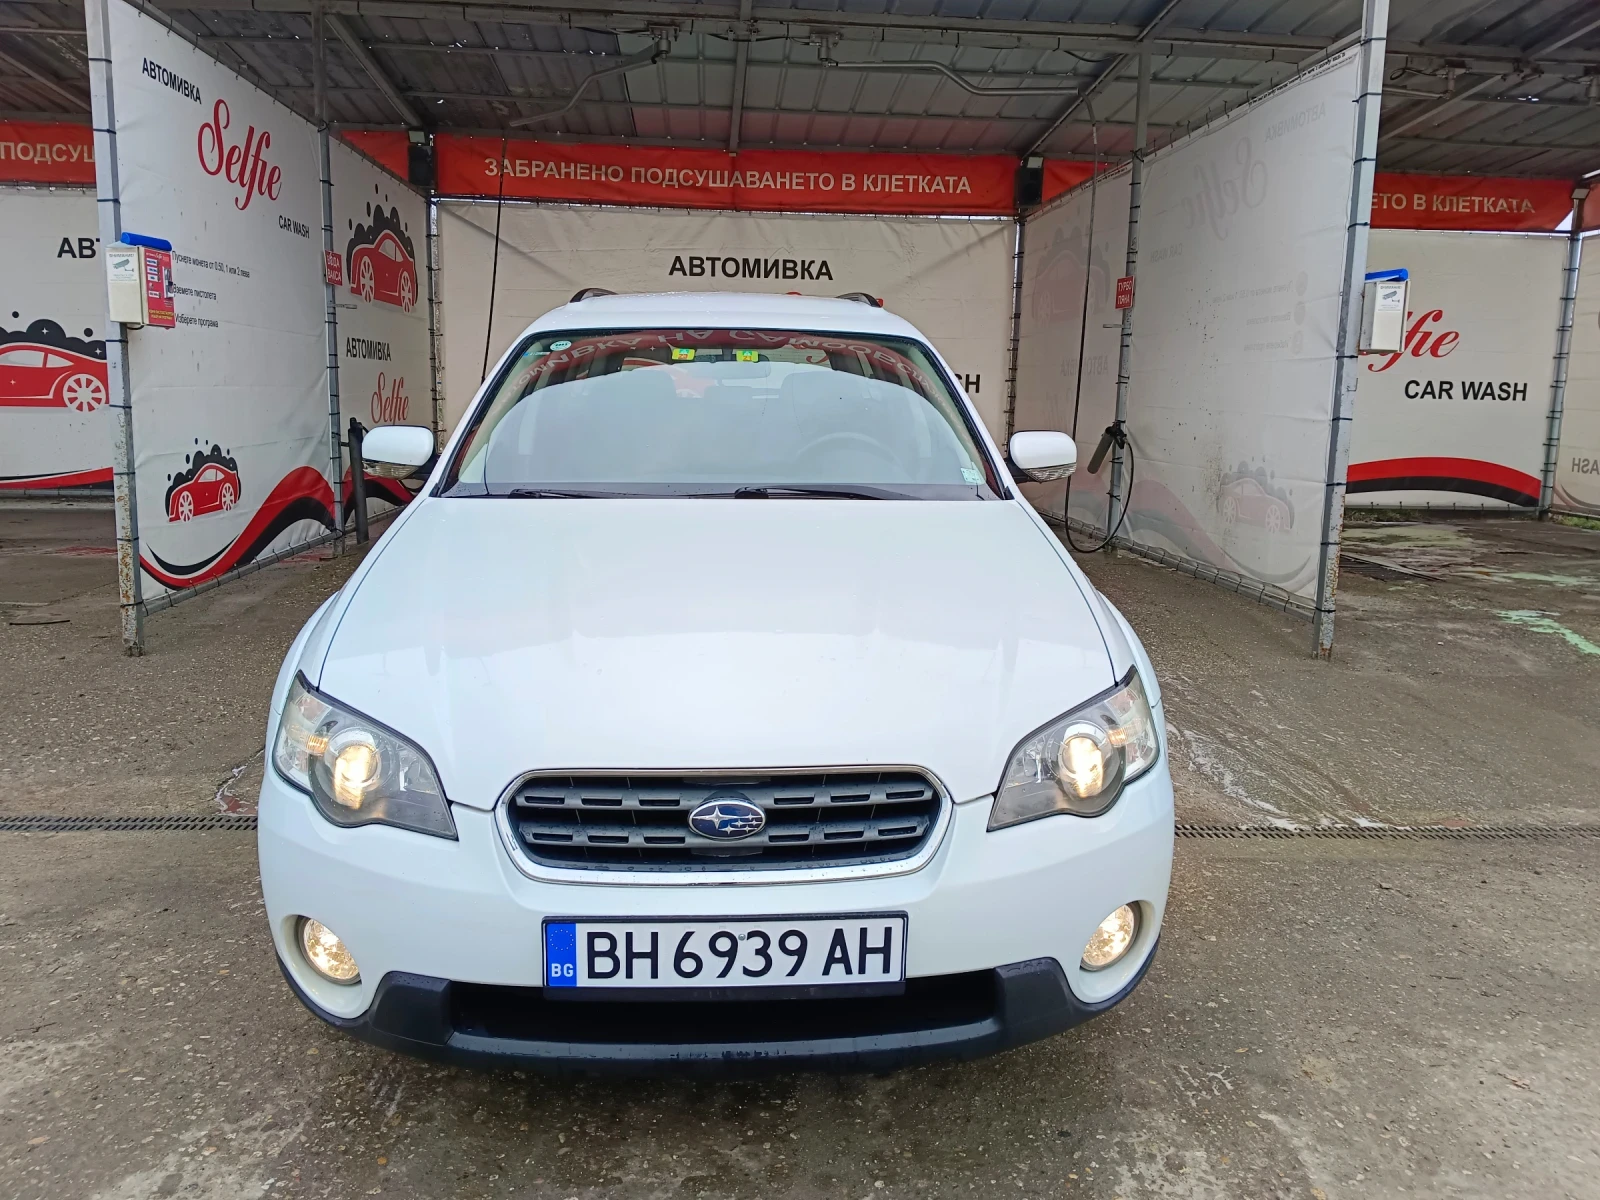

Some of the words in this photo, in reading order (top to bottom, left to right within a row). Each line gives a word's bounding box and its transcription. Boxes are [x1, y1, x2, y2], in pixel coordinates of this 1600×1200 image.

[142, 57, 202, 105] АВТОМИВКА
[197, 98, 282, 211] Selfie
[484, 158, 624, 182] ЗАБРАНЕНО
[631, 166, 835, 191] ПОДСУШАВАНЕТО
[841, 173, 856, 191] В
[863, 173, 971, 194] КЛЕТКАТА
[1413, 194, 1427, 210] В
[1432, 195, 1535, 214] КЛЕТКАТА
[278, 214, 292, 233] CAR
[292, 220, 310, 239] WASH
[57, 237, 100, 258] АВ
[172, 251, 192, 264] Пуснете
[668, 255, 834, 281] АВТОМИВКА
[193, 289, 217, 300] пистолета
[1118, 280, 1132, 292] ТУРБО
[197, 318, 219, 328] програма
[346, 337, 392, 361] АВТОМИВКА
[371, 372, 409, 426] Selfie
[1404, 379, 1454, 400] CAR
[1461, 381, 1528, 402] WASH
[586, 931, 659, 980] BH
[673, 928, 808, 979] 6939
[821, 926, 893, 976] AH
[551, 963, 574, 978] BG
